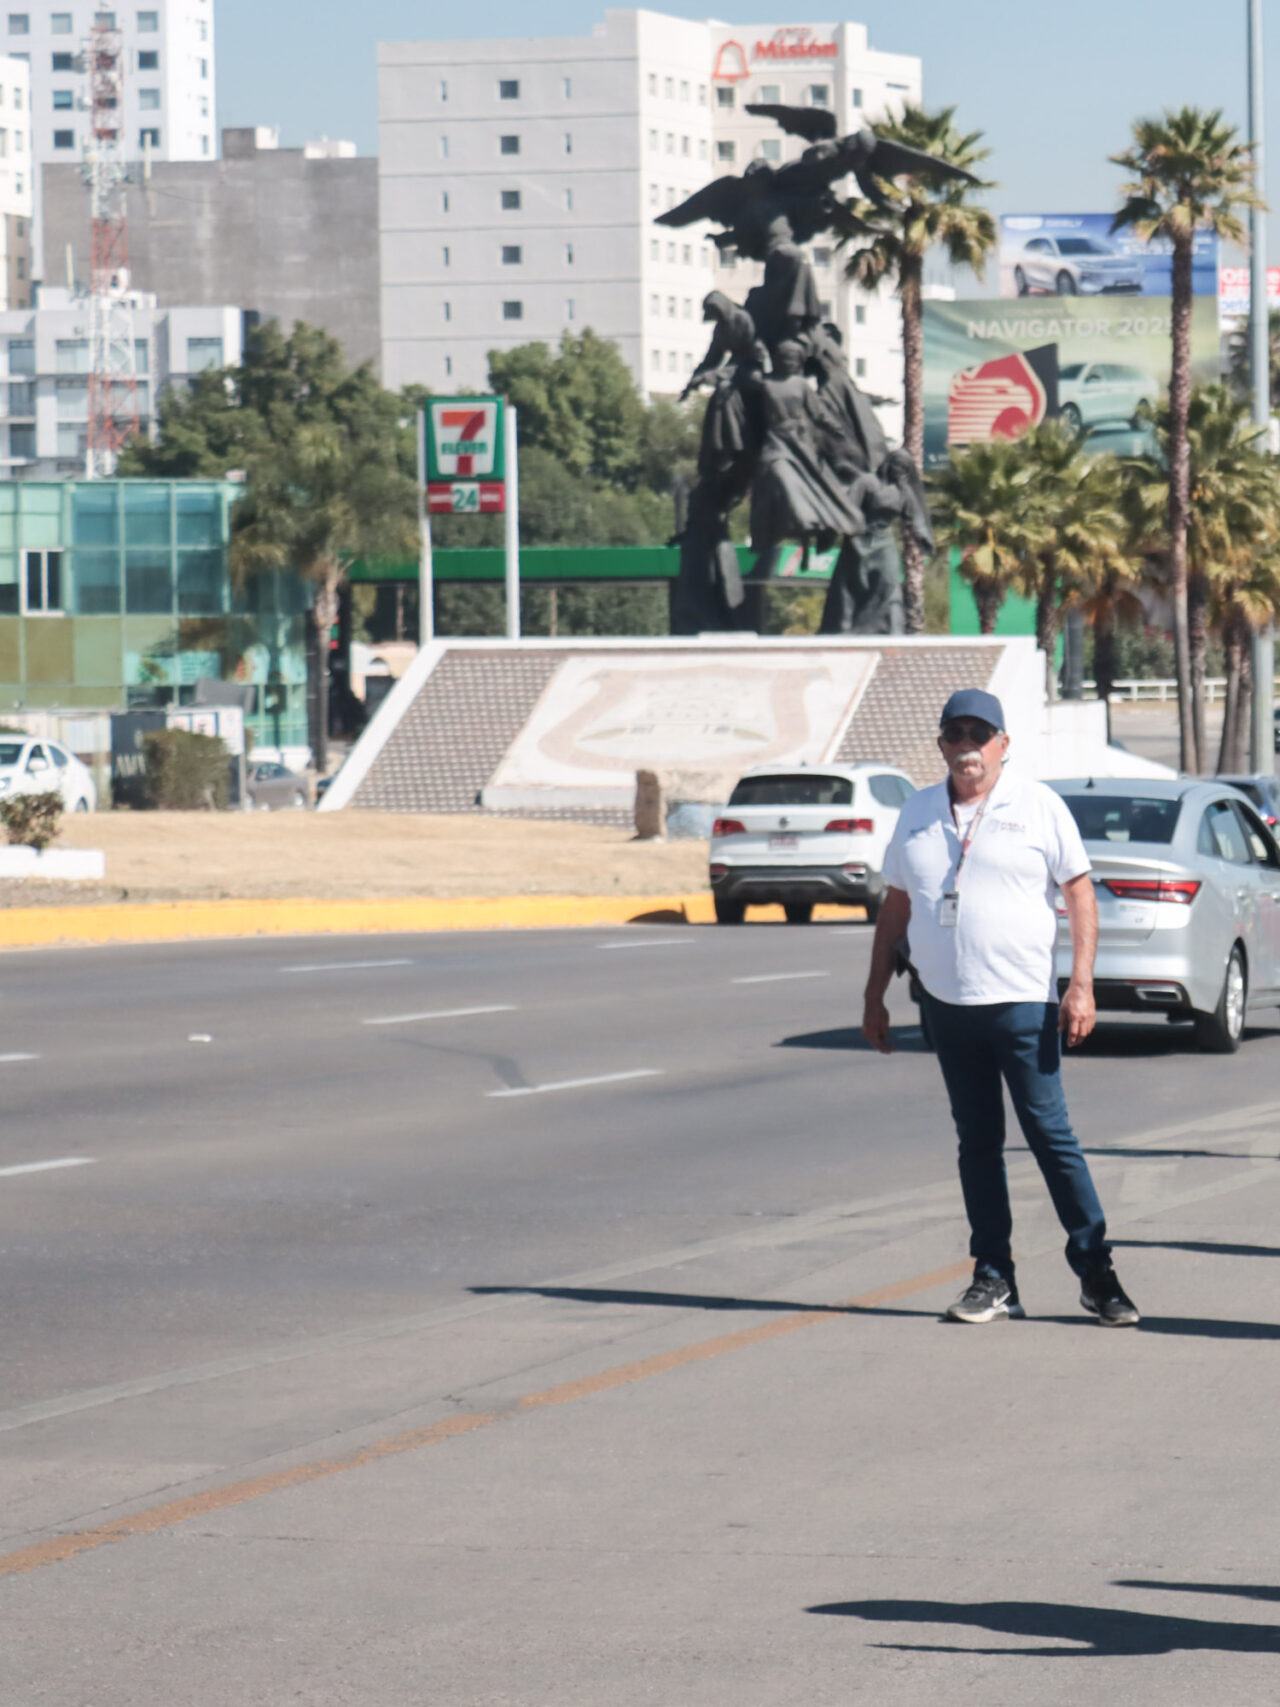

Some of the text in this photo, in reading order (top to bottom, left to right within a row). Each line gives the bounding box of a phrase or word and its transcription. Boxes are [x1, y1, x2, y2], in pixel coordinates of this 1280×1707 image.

[754, 38, 838, 60] Misión
[967, 319, 1110, 339] NAVIGATOR
[441, 410, 486, 477] 7
[453, 489, 478, 510] 24
